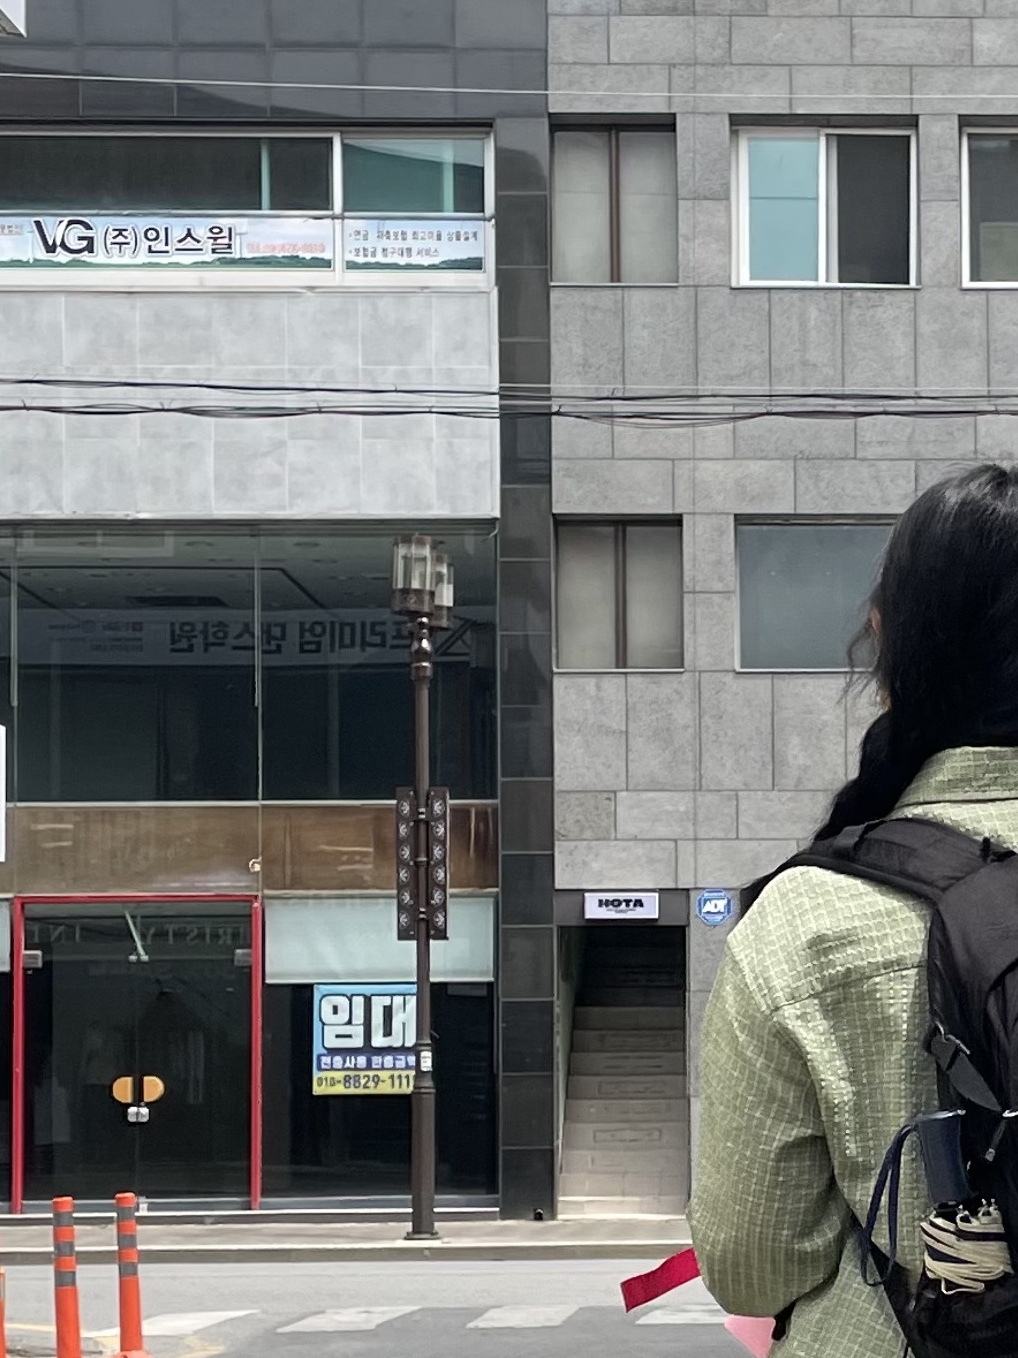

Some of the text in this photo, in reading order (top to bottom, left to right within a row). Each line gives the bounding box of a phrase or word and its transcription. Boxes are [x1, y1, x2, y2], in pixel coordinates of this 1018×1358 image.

[33, 217, 96, 254] VG
[320, 994, 416, 1048] 임대
[316, 1074, 414, 1089] 010-8829-111
